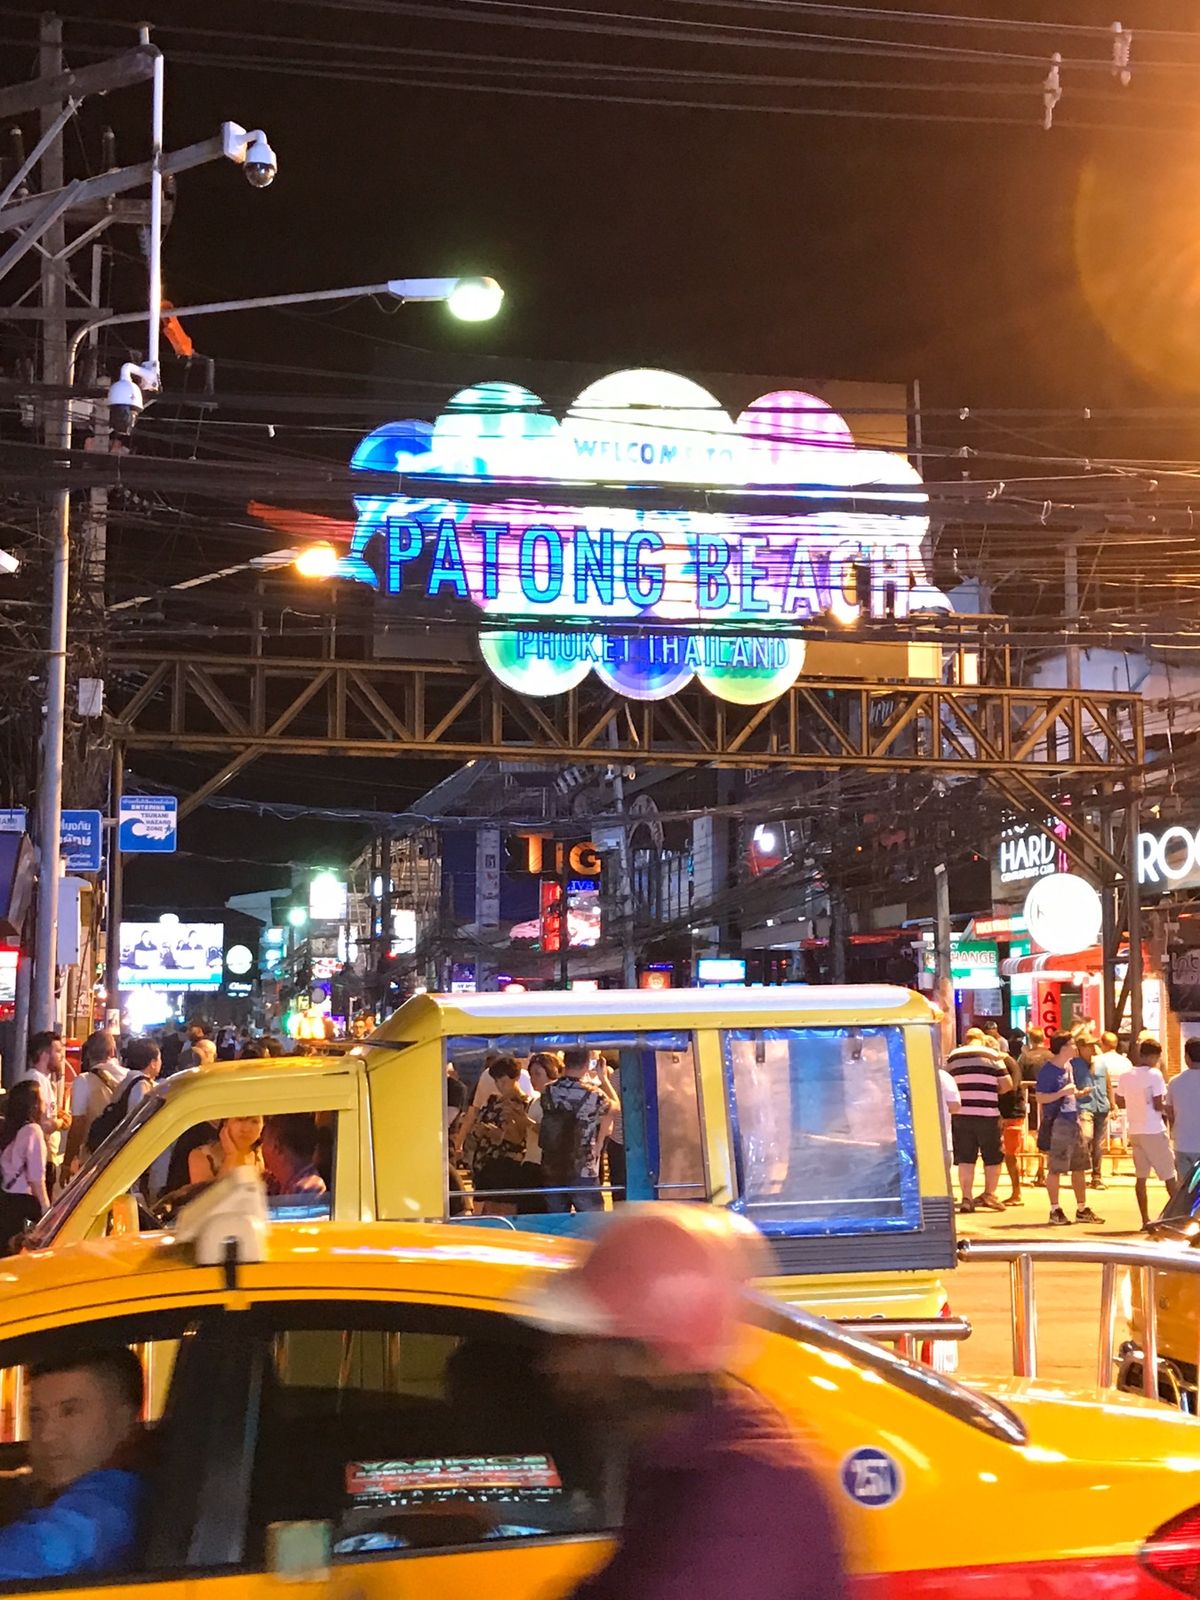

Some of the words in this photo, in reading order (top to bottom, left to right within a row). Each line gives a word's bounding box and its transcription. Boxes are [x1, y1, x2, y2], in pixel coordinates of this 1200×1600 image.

[386, 514, 667, 607] PATONG
[694, 532, 913, 621] BEACH
[517, 631, 631, 663] PHUKET
[649, 634, 791, 670] THAILAND
[1001, 833, 1056, 873] HARD
[1137, 825, 1200, 884] RO
